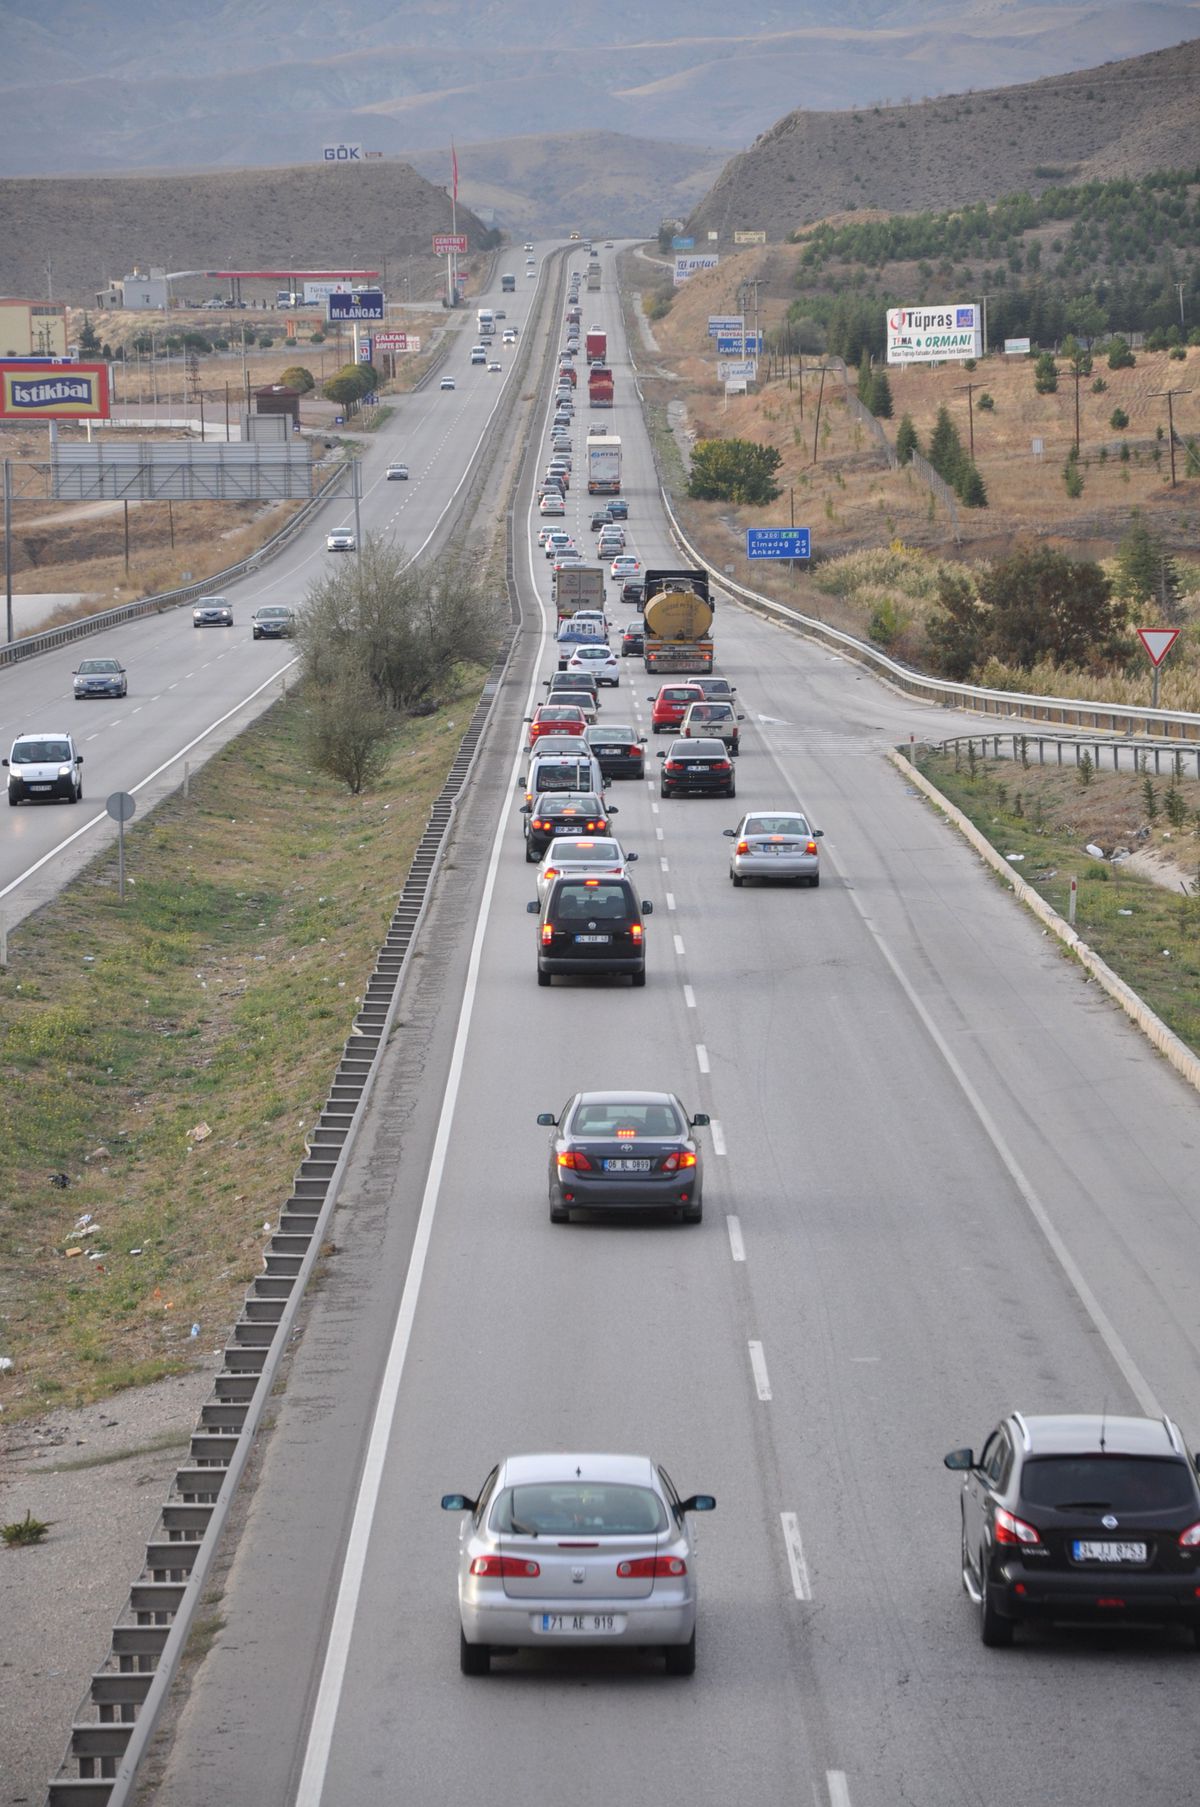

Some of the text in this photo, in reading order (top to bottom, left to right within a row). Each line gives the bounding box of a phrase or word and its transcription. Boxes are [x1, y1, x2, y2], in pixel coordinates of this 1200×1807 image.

[324, 145, 360, 160] GÖK
[906, 312, 953, 331] Tüpraş
[925, 334, 972, 347] ORMANI
[15, 382, 88, 402] istikbal
[751, 540, 789, 548] Elmadağ
[550, 1616, 614, 1630] 71 AE 919
